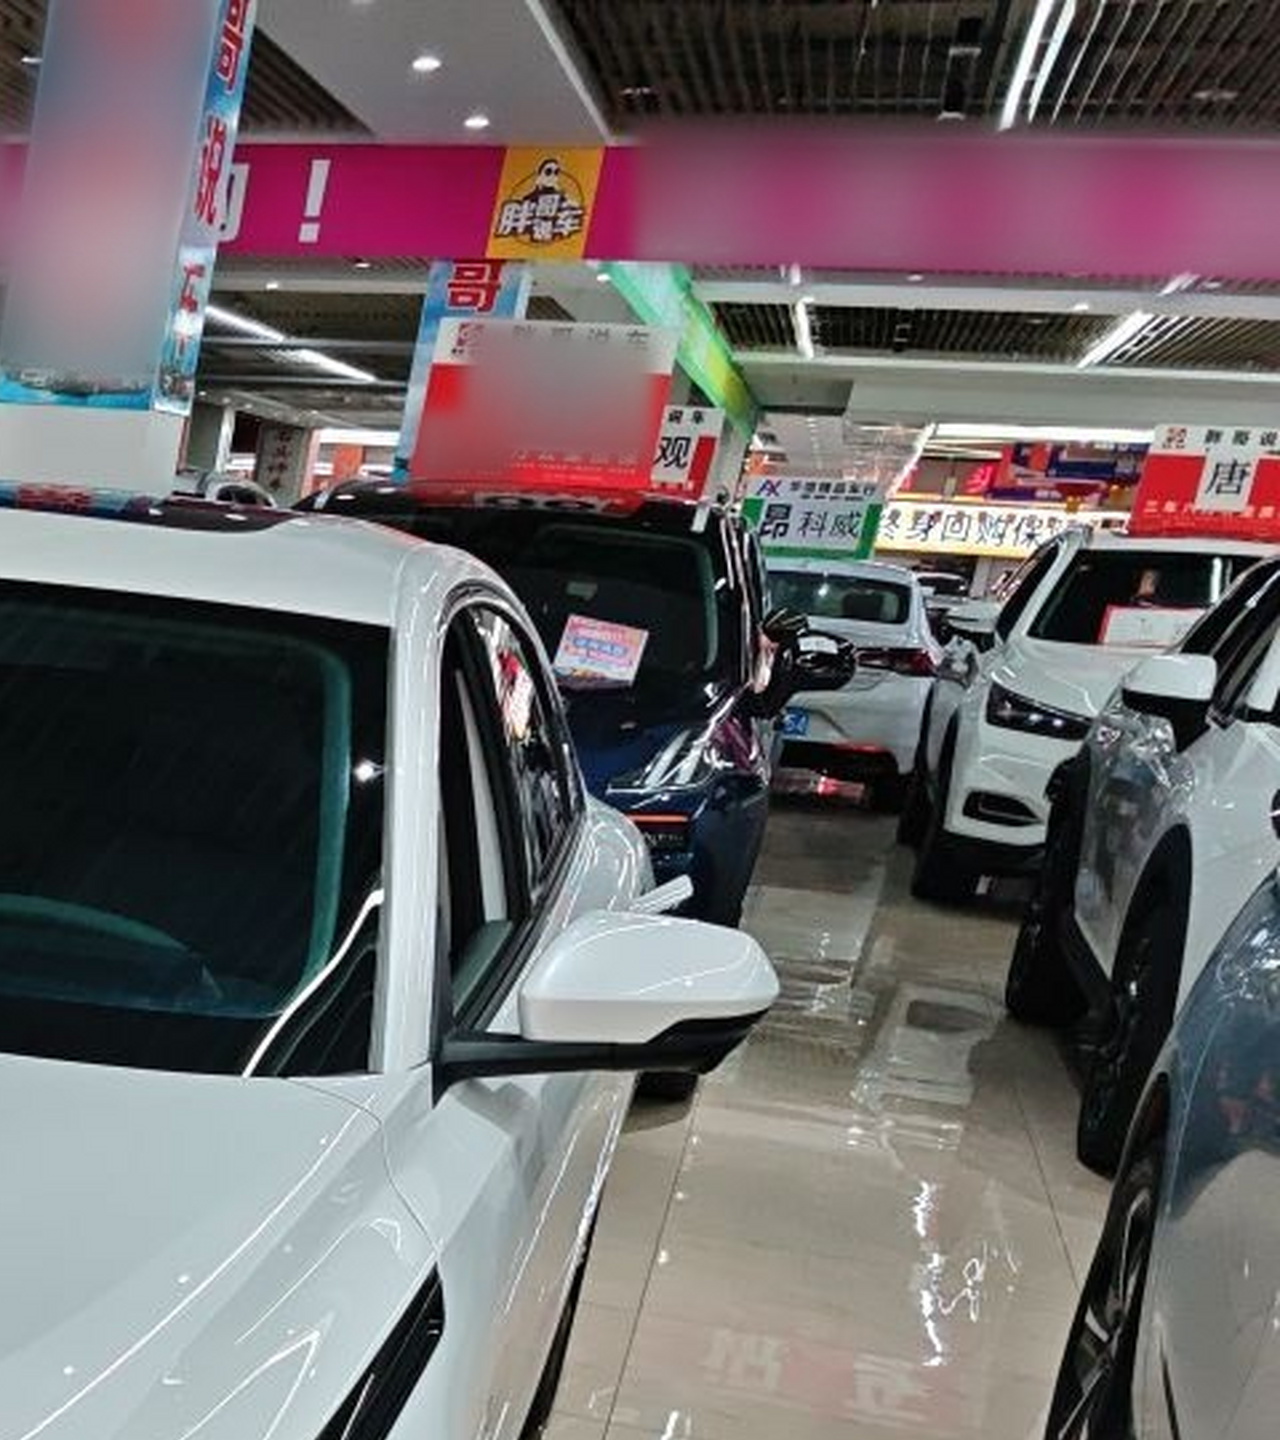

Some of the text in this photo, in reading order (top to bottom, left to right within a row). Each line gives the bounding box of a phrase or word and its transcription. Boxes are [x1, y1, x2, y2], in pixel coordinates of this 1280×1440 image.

[497, 194, 583, 241] 胖哥说车
[652, 435, 691, 468] 观
[1204, 459, 1252, 494] 唐
[759, 503, 862, 540] 昂科威
